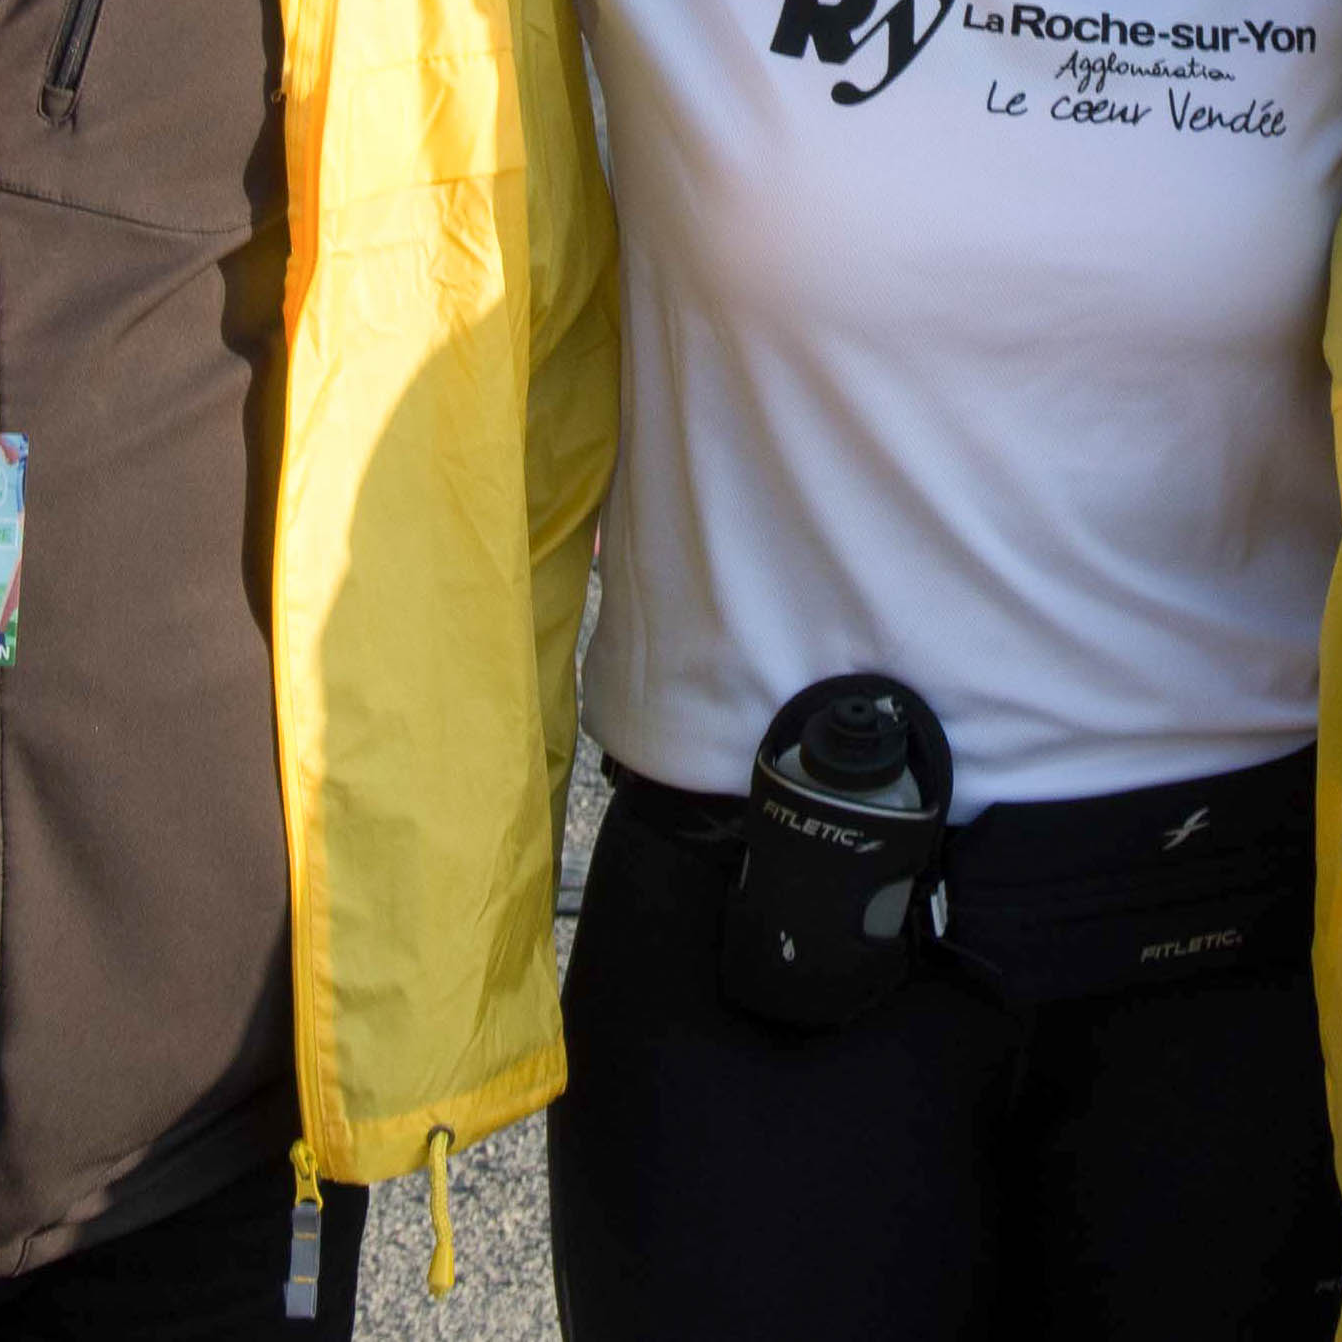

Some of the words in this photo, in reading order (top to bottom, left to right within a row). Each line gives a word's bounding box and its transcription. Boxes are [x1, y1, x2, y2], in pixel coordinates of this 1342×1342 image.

[963, 3, 1006, 34] La
[1011, 3, 1317, 54] Roche-sur-Yon
[1054, 49, 1236, 93] Agglomération
[986, 81, 1029, 117] Le
[1167, 87, 1288, 138] Vendée
